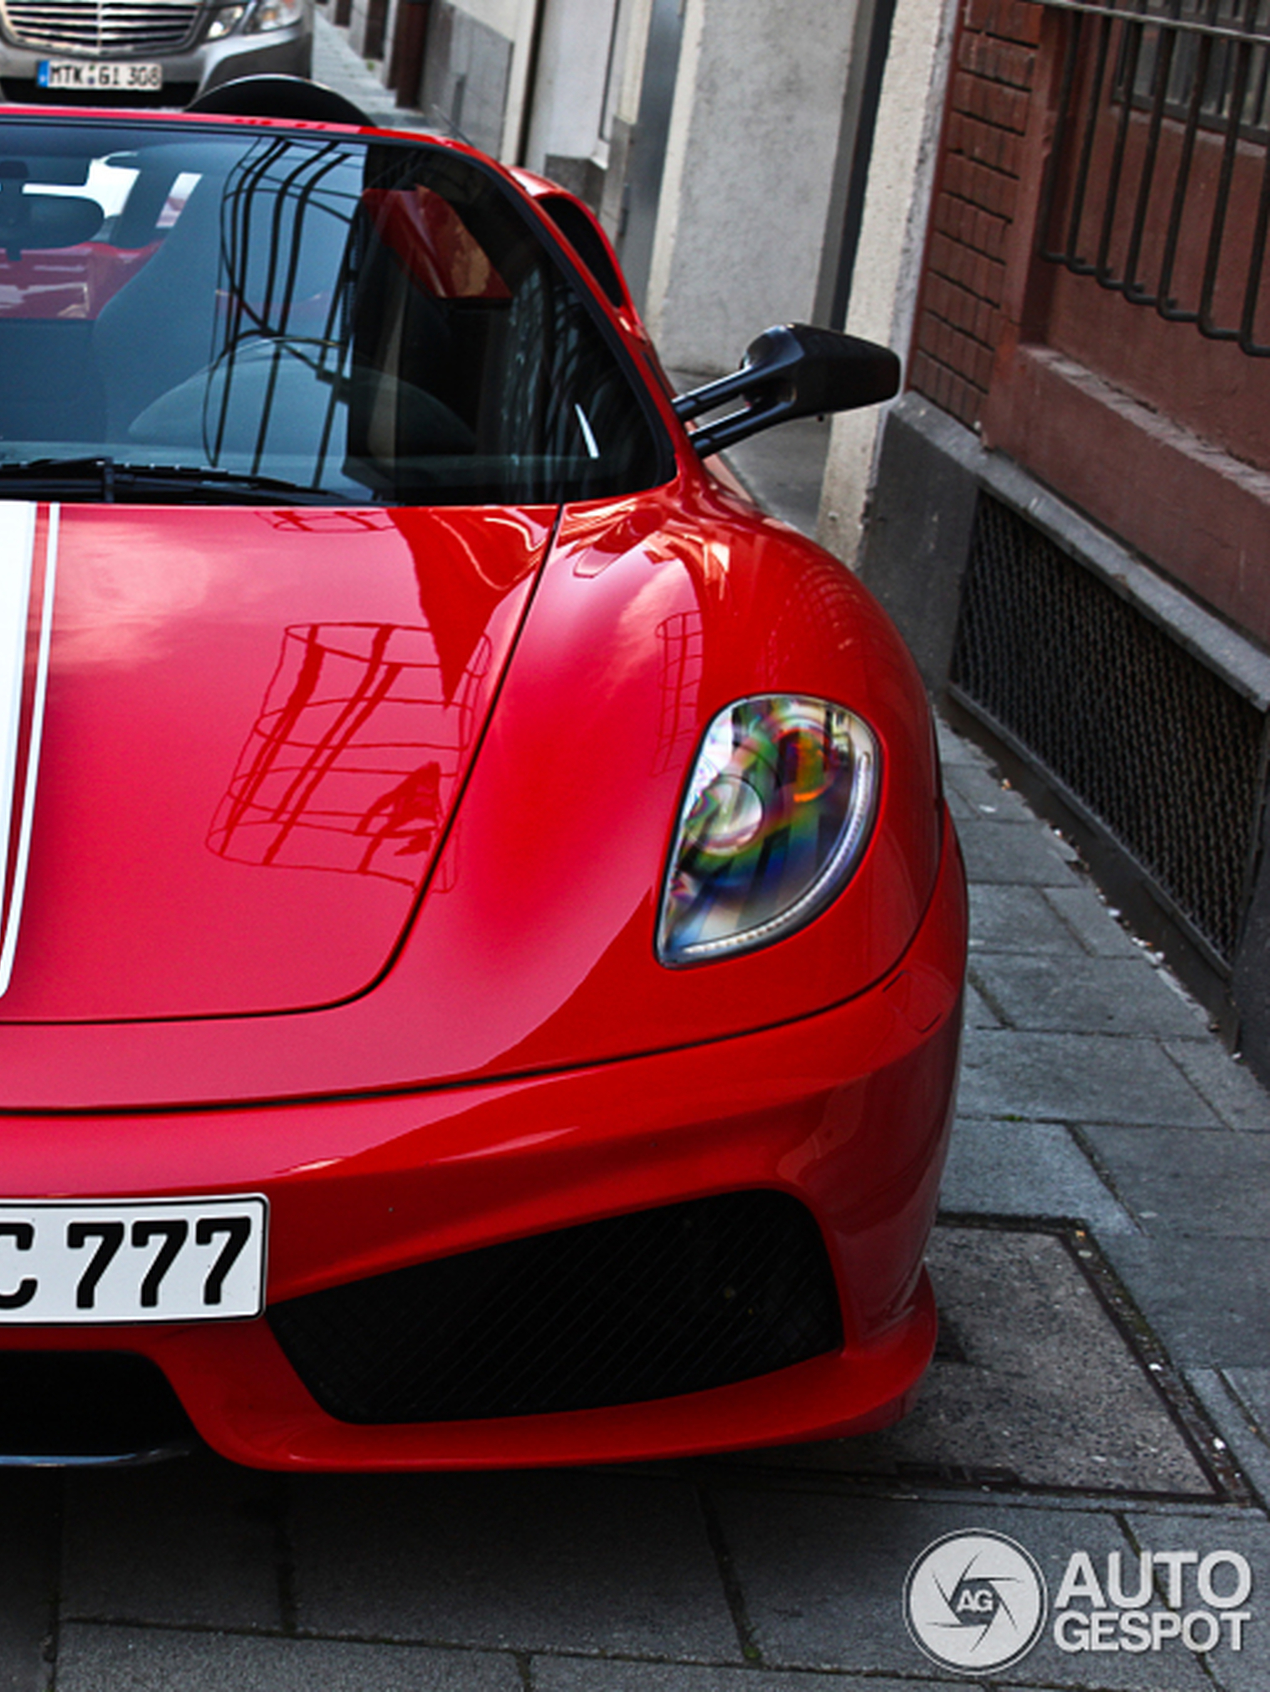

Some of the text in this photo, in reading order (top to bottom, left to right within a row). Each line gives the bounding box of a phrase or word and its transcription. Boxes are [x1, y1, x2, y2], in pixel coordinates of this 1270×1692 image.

[51, 65, 84, 84] MTK
[126, 66, 160, 87] 308
[66, 1215, 253, 1310] 777
